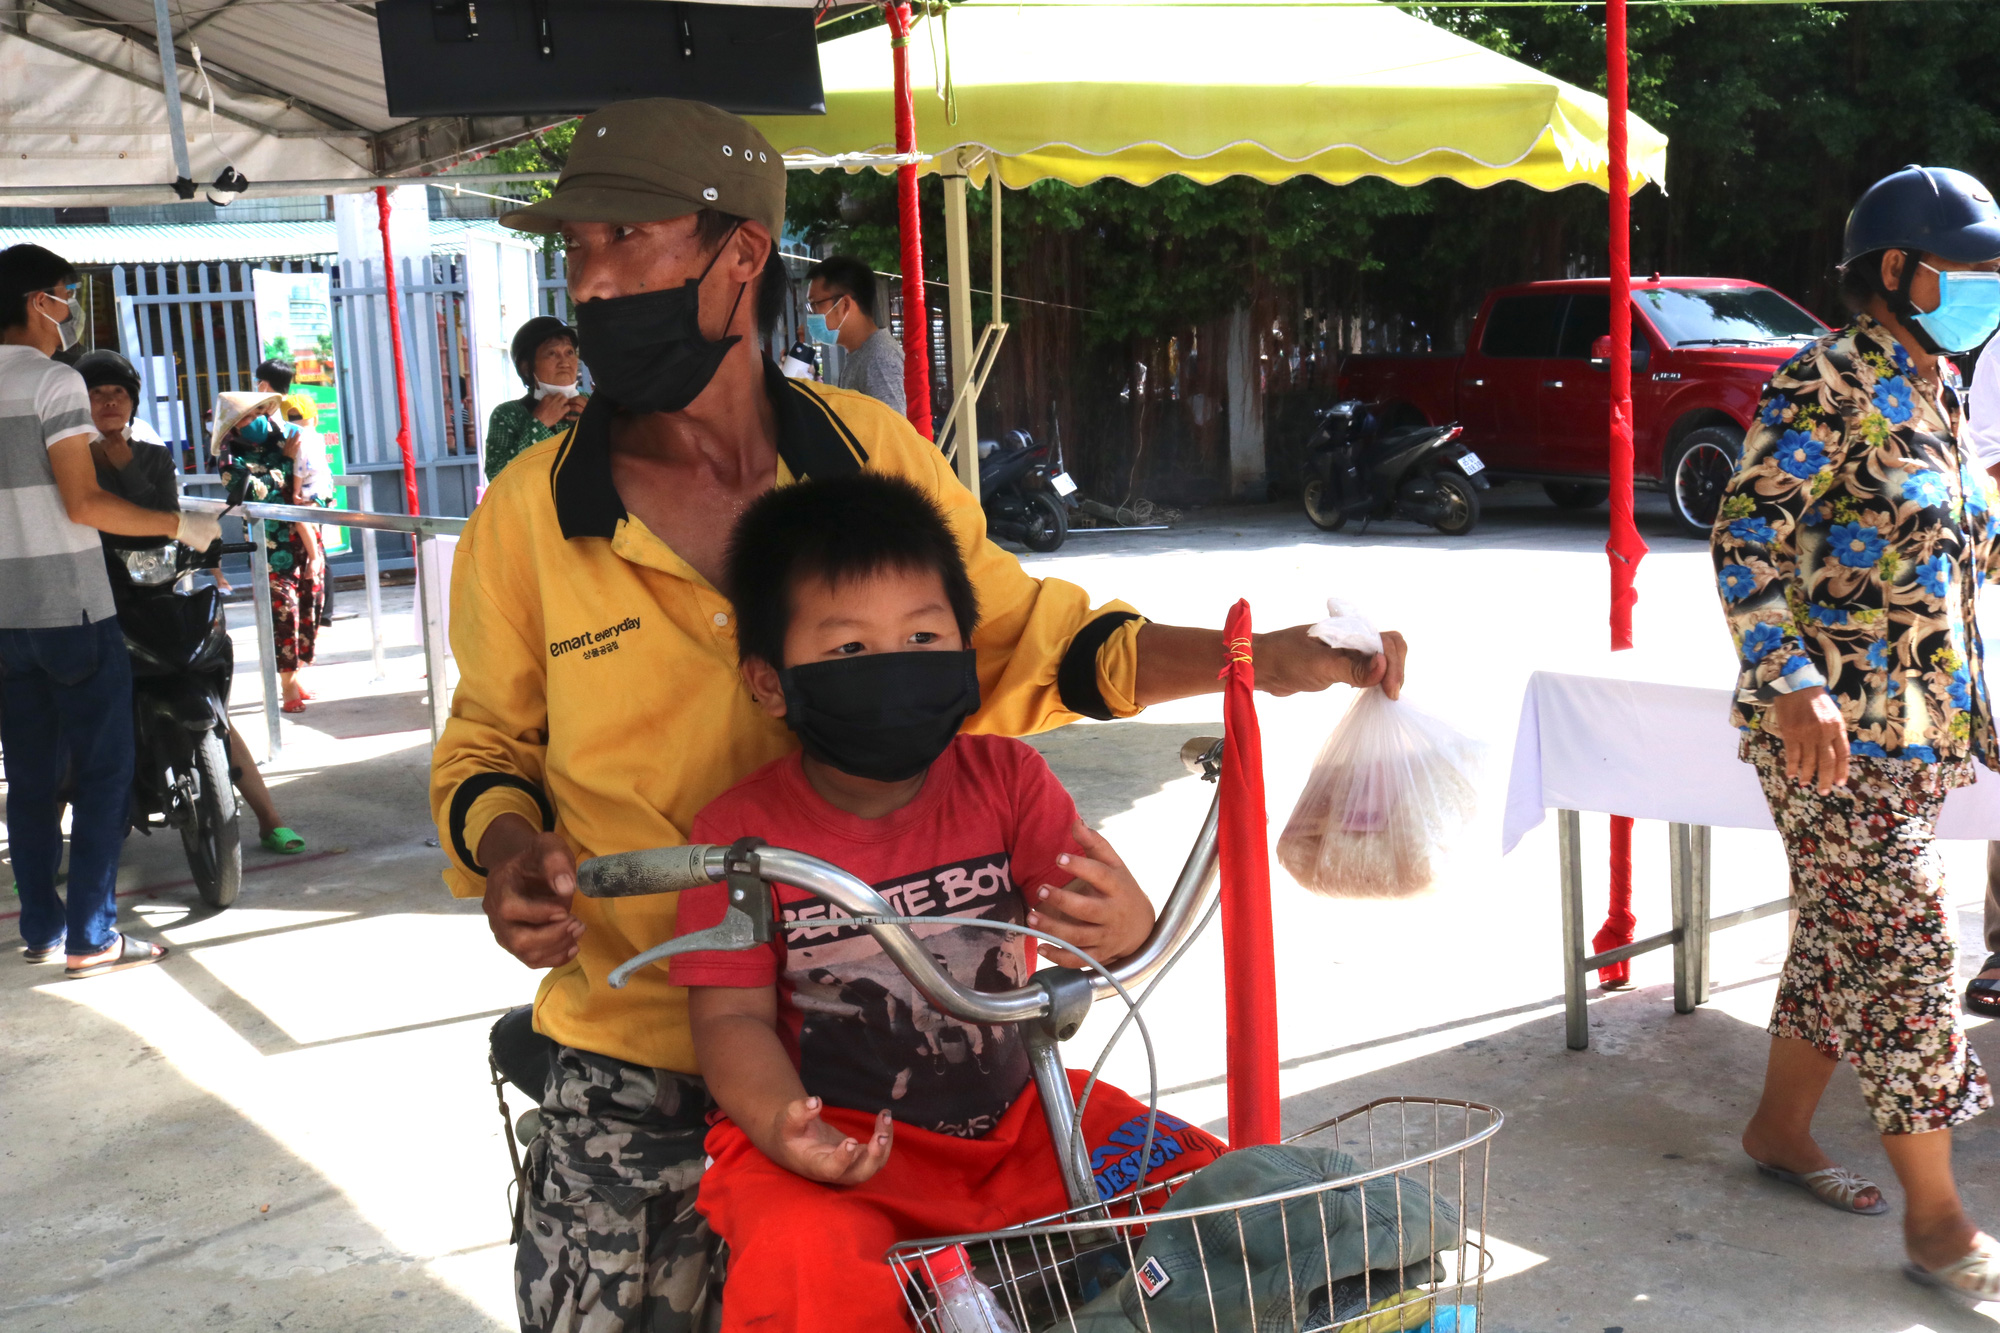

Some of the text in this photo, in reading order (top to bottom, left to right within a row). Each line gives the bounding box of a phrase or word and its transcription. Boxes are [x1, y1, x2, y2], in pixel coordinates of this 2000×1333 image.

[550, 617, 640, 657] emart everyday
[1094, 1135, 1184, 1201] DESIGN
